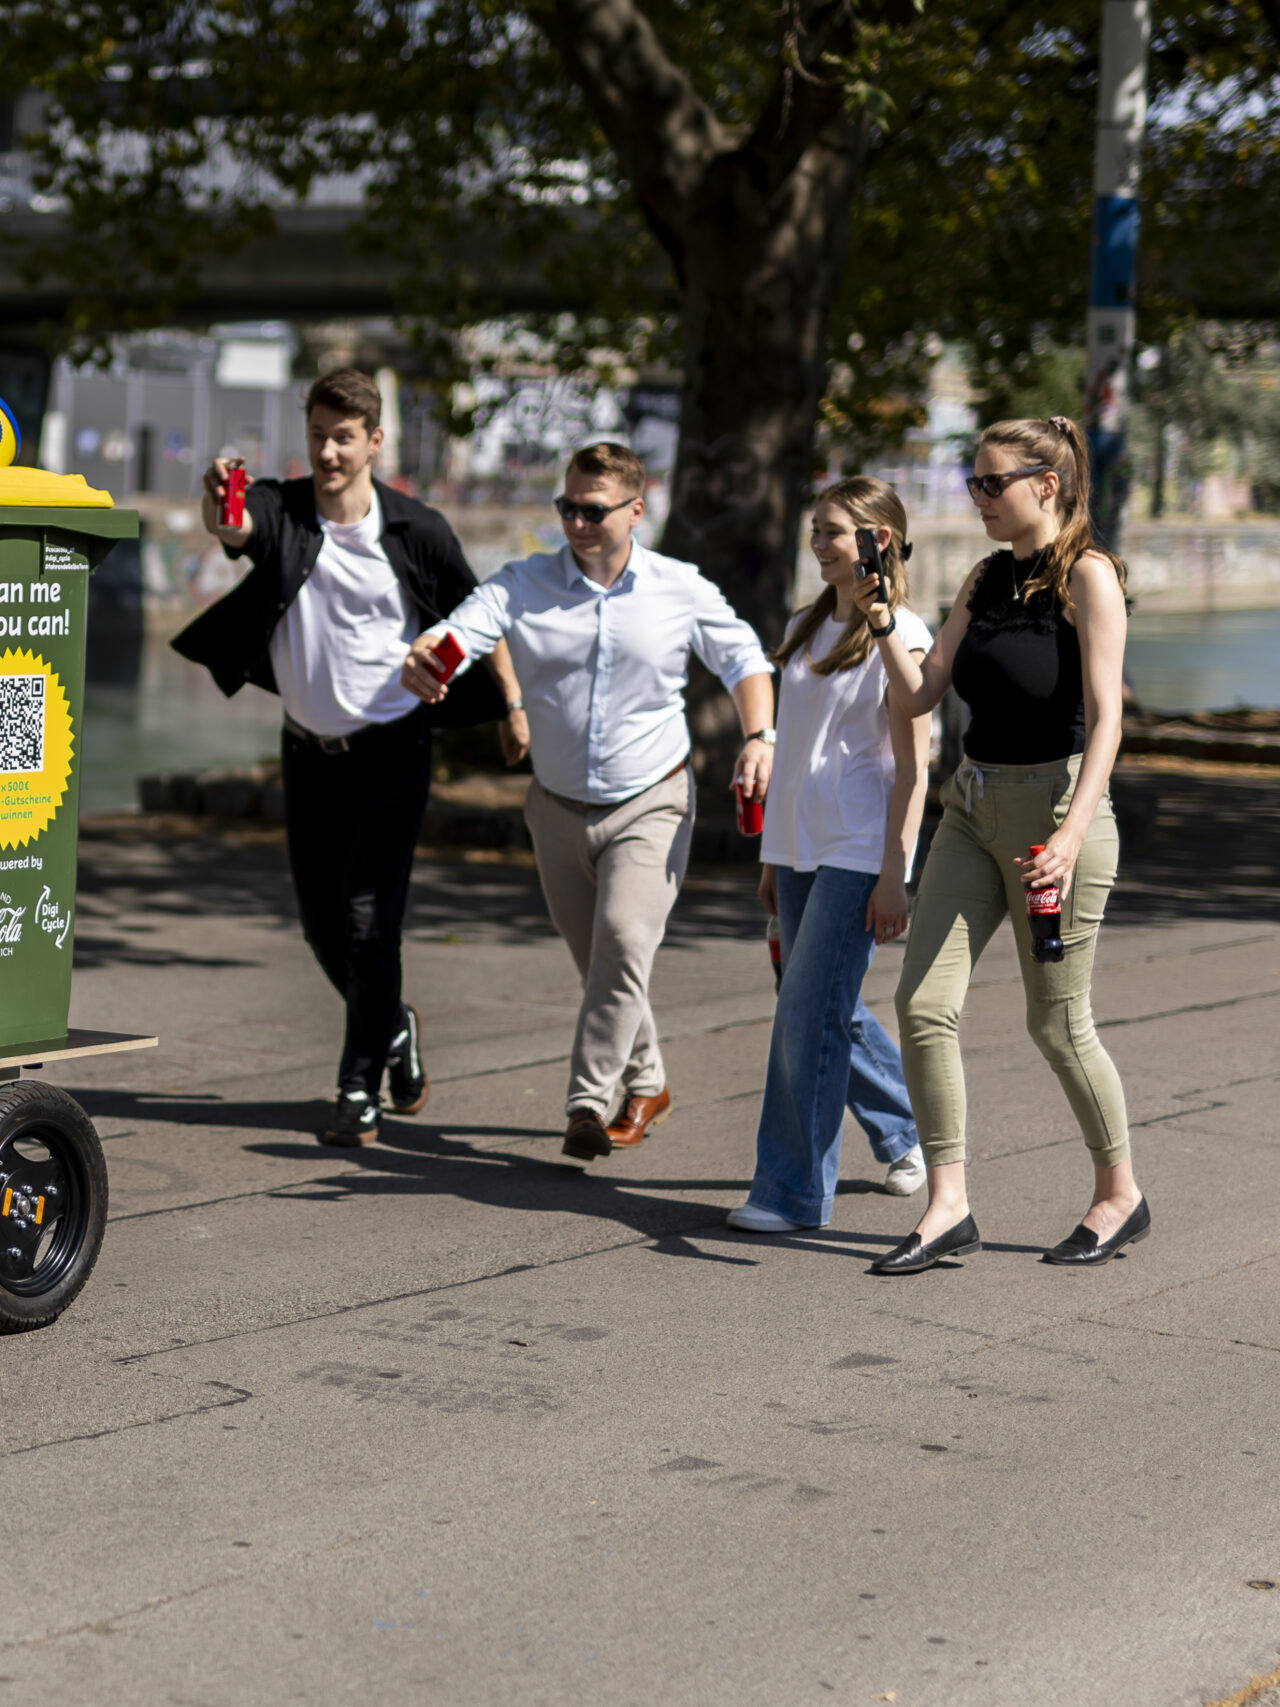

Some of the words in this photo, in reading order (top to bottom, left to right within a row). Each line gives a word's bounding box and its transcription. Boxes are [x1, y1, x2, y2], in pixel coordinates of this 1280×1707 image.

[29, 583, 61, 603] me
[27, 608, 70, 636] can!
[30, 855, 43, 871] by
[41, 902, 60, 918] Digi
[41, 917, 65, 933] Cycle
